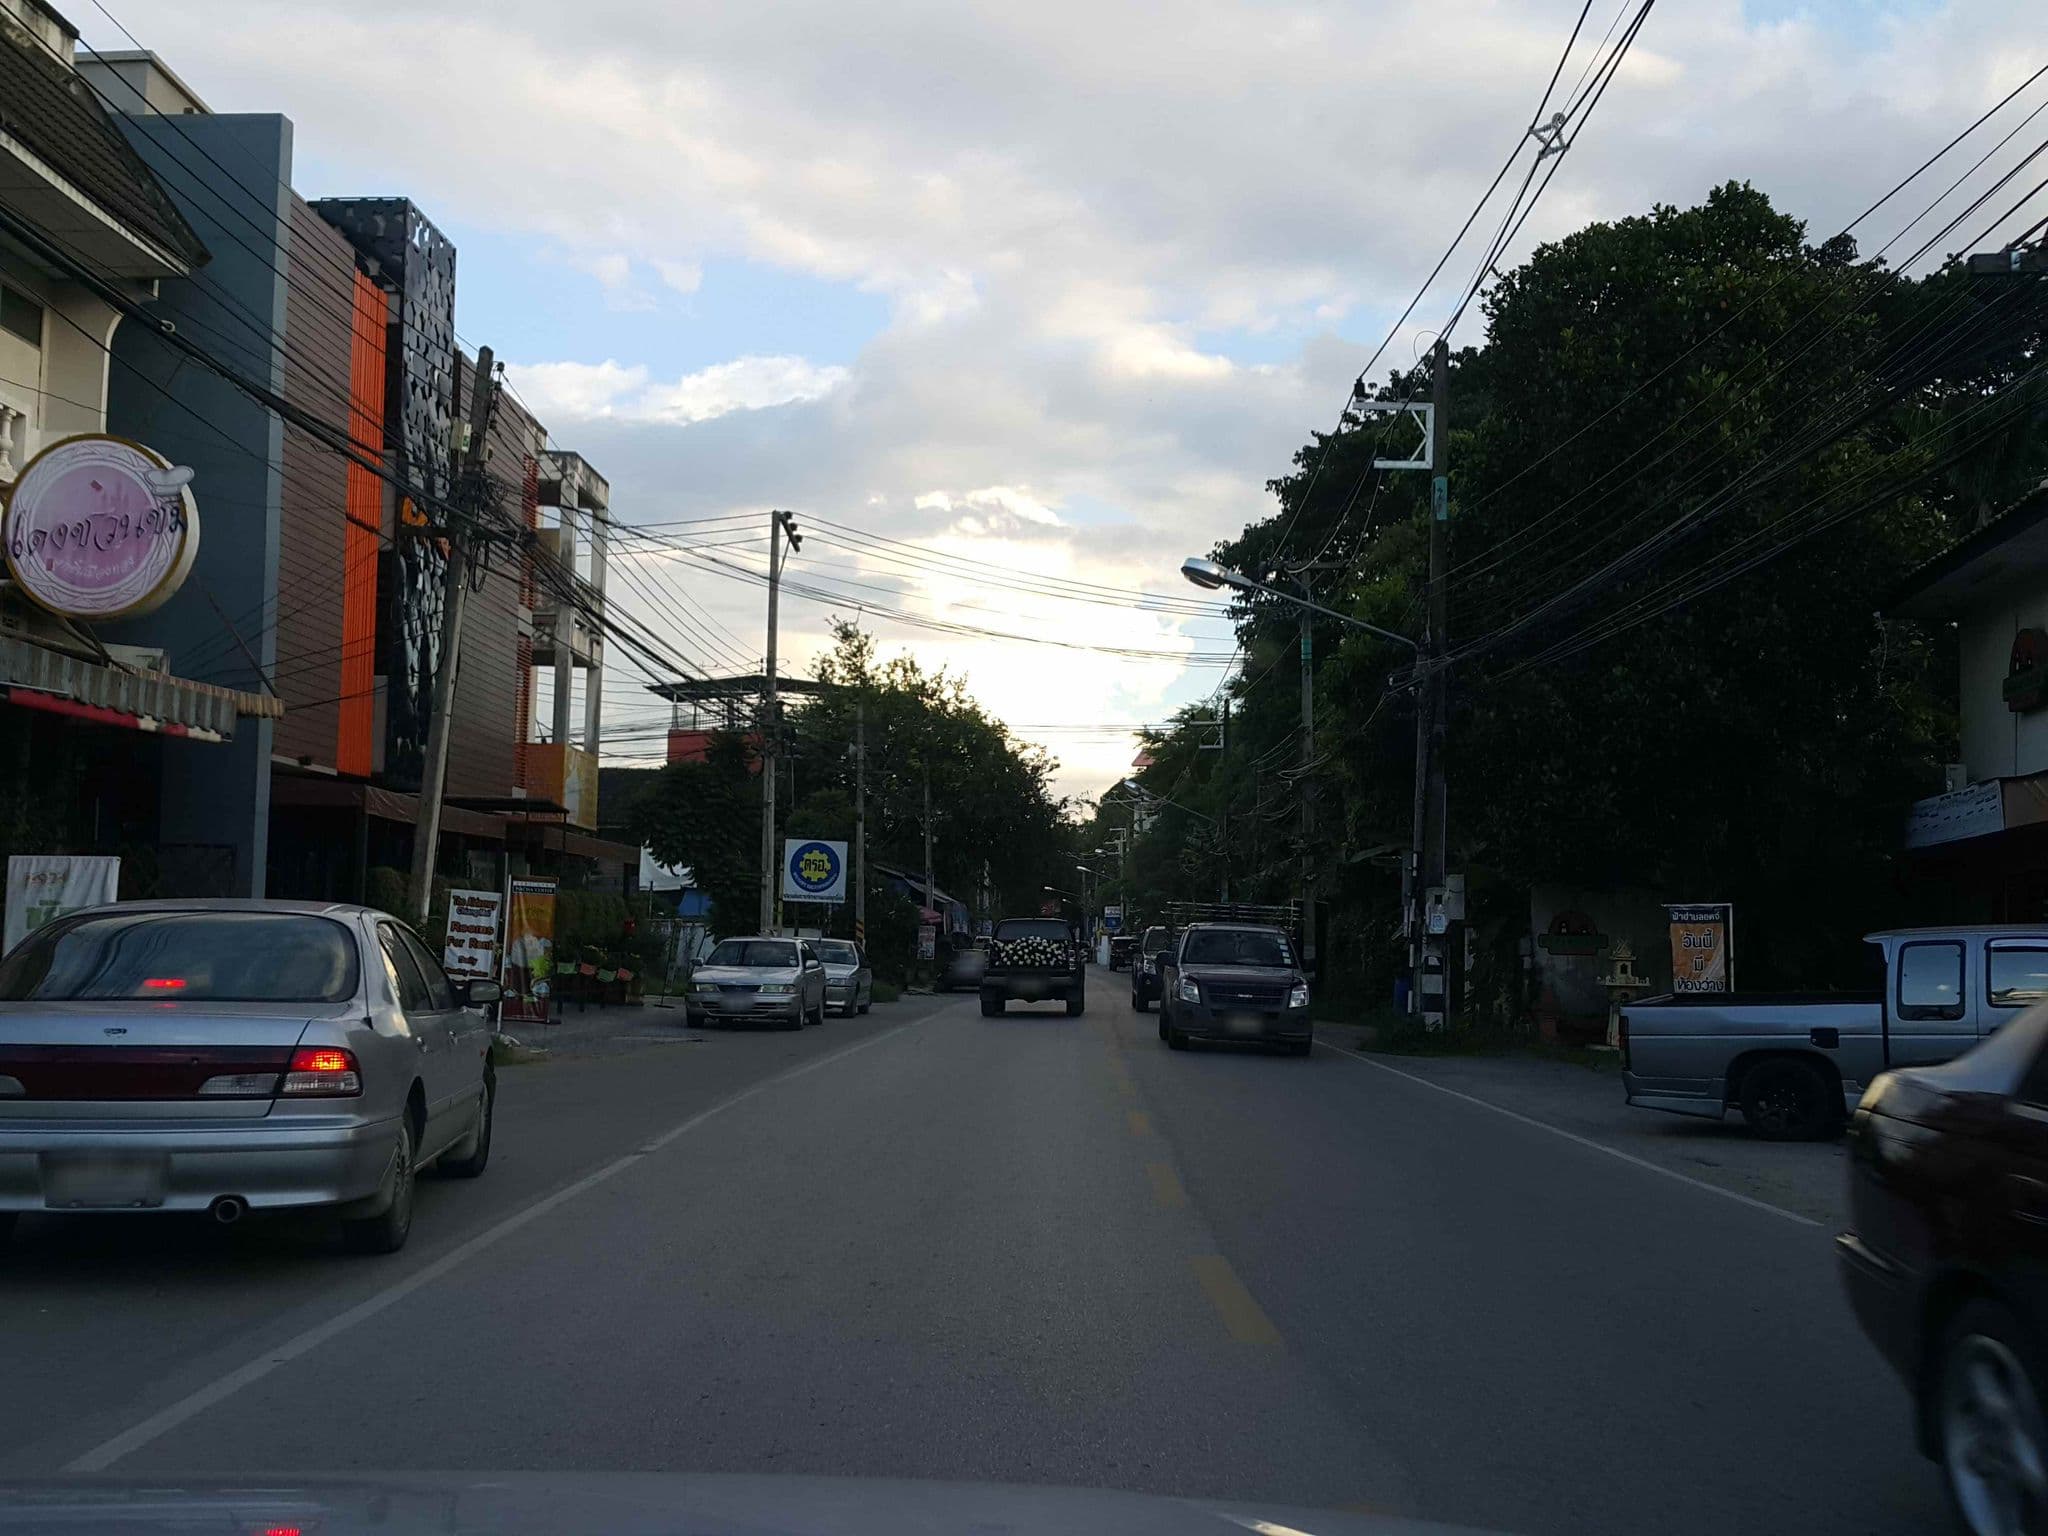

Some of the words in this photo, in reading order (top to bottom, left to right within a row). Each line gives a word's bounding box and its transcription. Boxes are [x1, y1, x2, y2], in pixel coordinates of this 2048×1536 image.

[451, 921, 494, 935] Rooms
[447, 936, 465, 948] For
[469, 938, 494, 950] Rent
[1682, 929, 1713, 949] วันนี้
[1693, 955, 1705, 973] มี
[1676, 976, 1724, 991] ห้องว่าง
